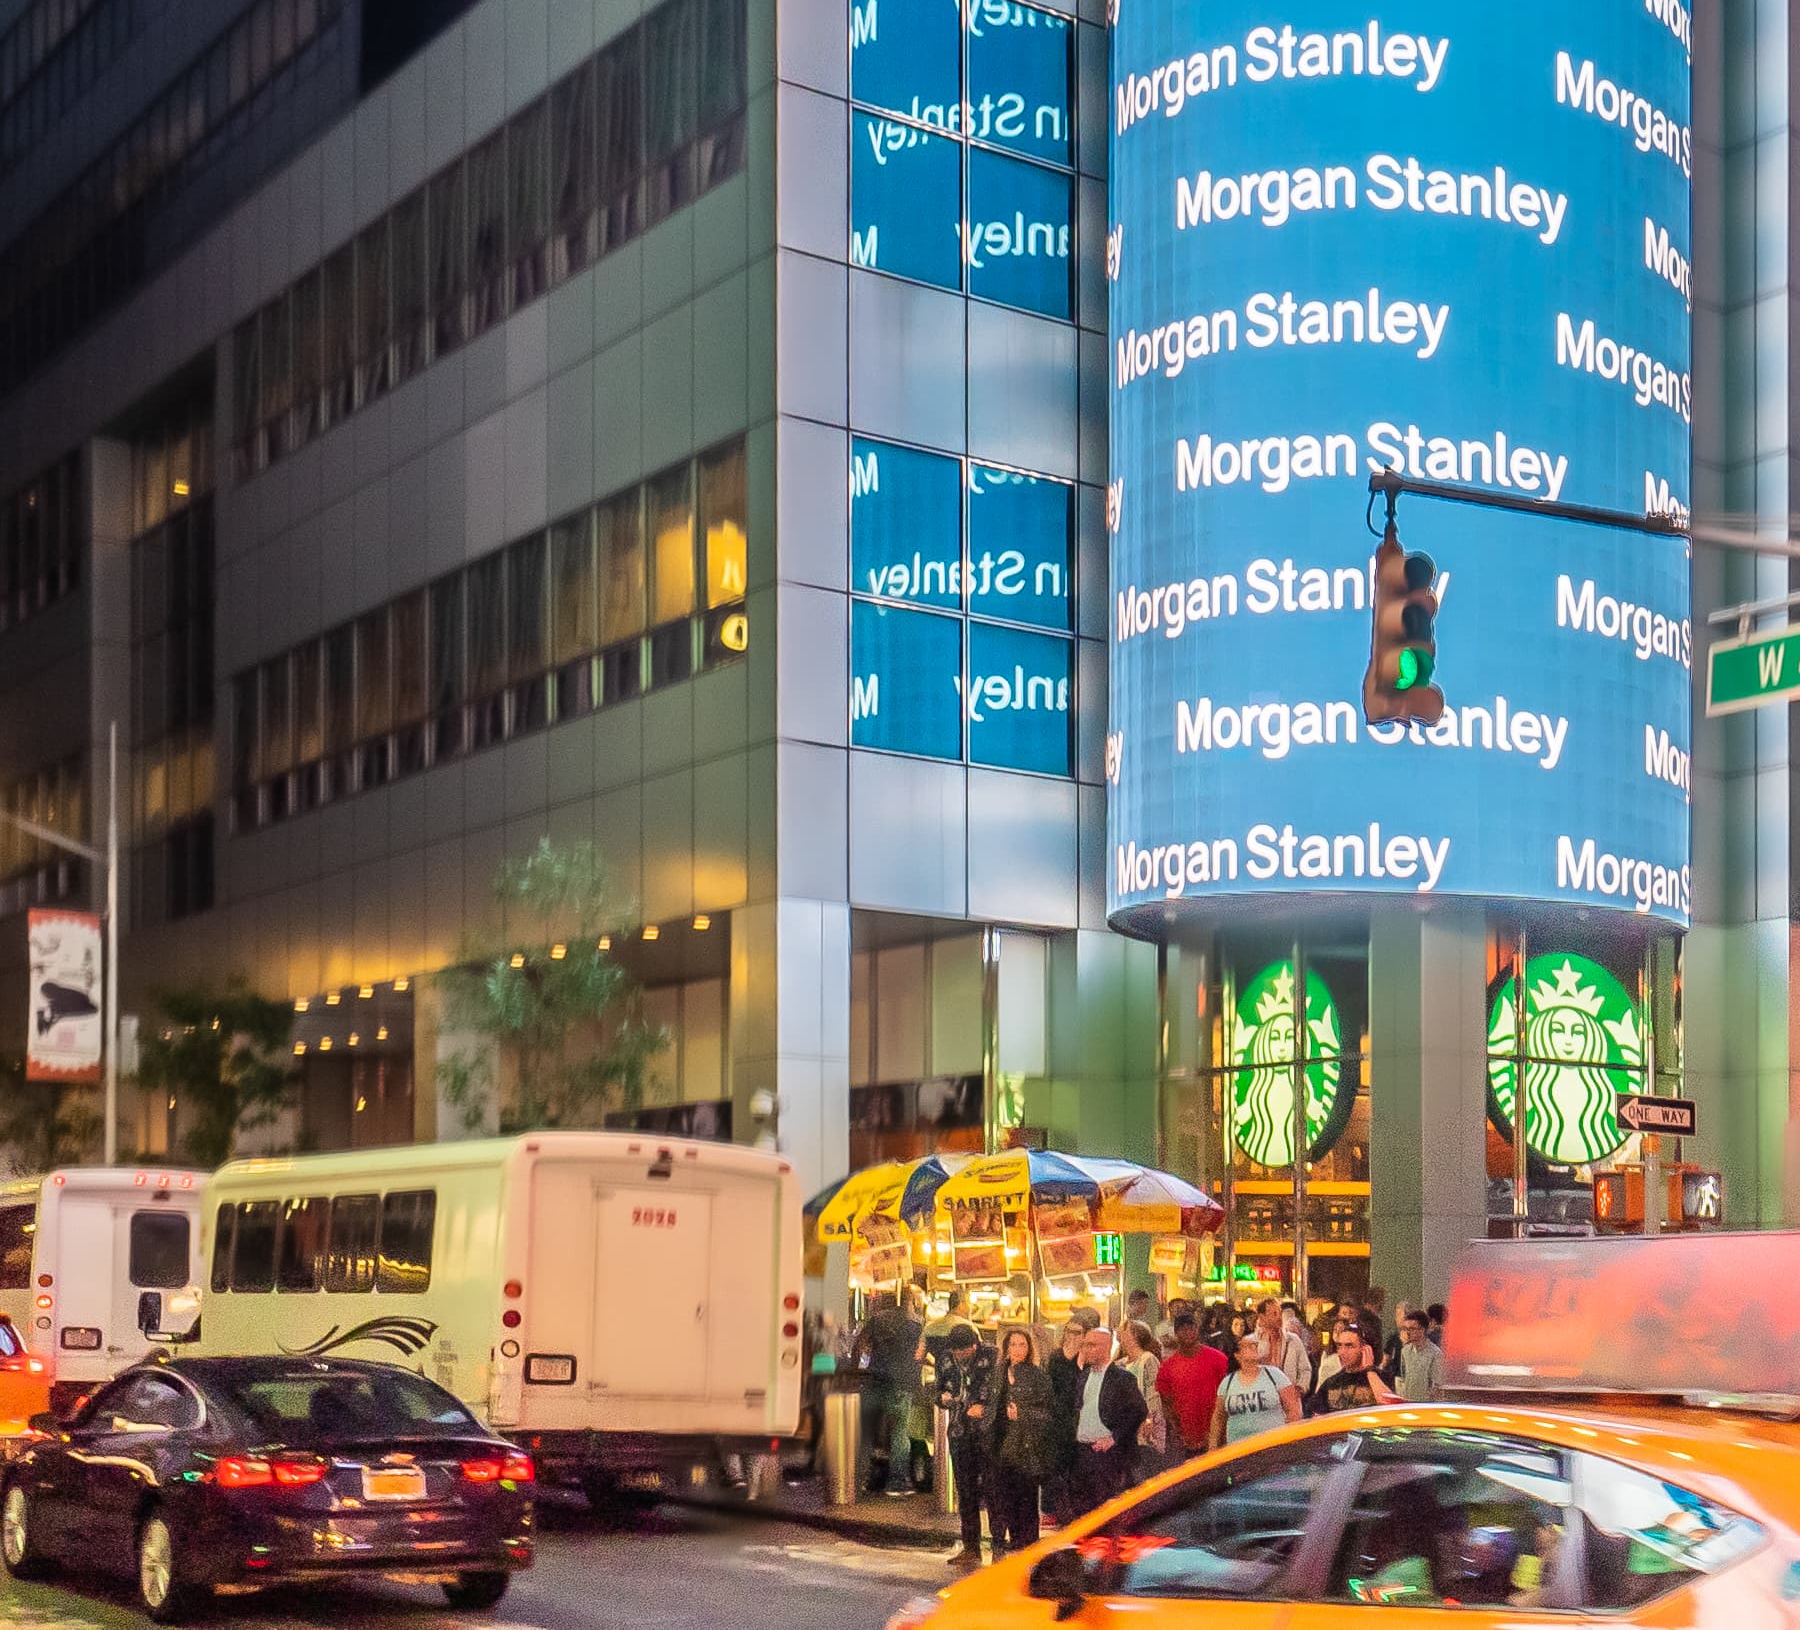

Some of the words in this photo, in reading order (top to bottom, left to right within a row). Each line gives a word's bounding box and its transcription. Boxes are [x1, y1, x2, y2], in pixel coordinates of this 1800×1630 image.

[1116, 44, 1237, 137] Morgan
[1245, 20, 1449, 93] Stanley
[1556, 51, 1682, 158] Morgan
[1177, 165, 1356, 231] Morgan
[1366, 154, 1567, 245] Stanley
[1116, 309, 1237, 390] Morgan
[1245, 287, 1450, 359] Stanley
[1556, 312, 1682, 416] Morgan
[1177, 432, 1356, 493] Morgan
[1367, 422, 1568, 502] Stanley
[1117, 568, 1237, 642] Morgan
[1556, 575, 1682, 658] Morgan
[1758, 642, 1784, 689] W
[1177, 697, 1356, 760] Morgan
[1117, 838, 1237, 899] Morgan
[1246, 822, 1450, 891] Stanley
[1556, 835, 1682, 913] Morgan
[1628, 1105, 1652, 1121] ONE
[1661, 1109, 1685, 1124] WAY
[1227, 1390, 1267, 1416] LOVE
